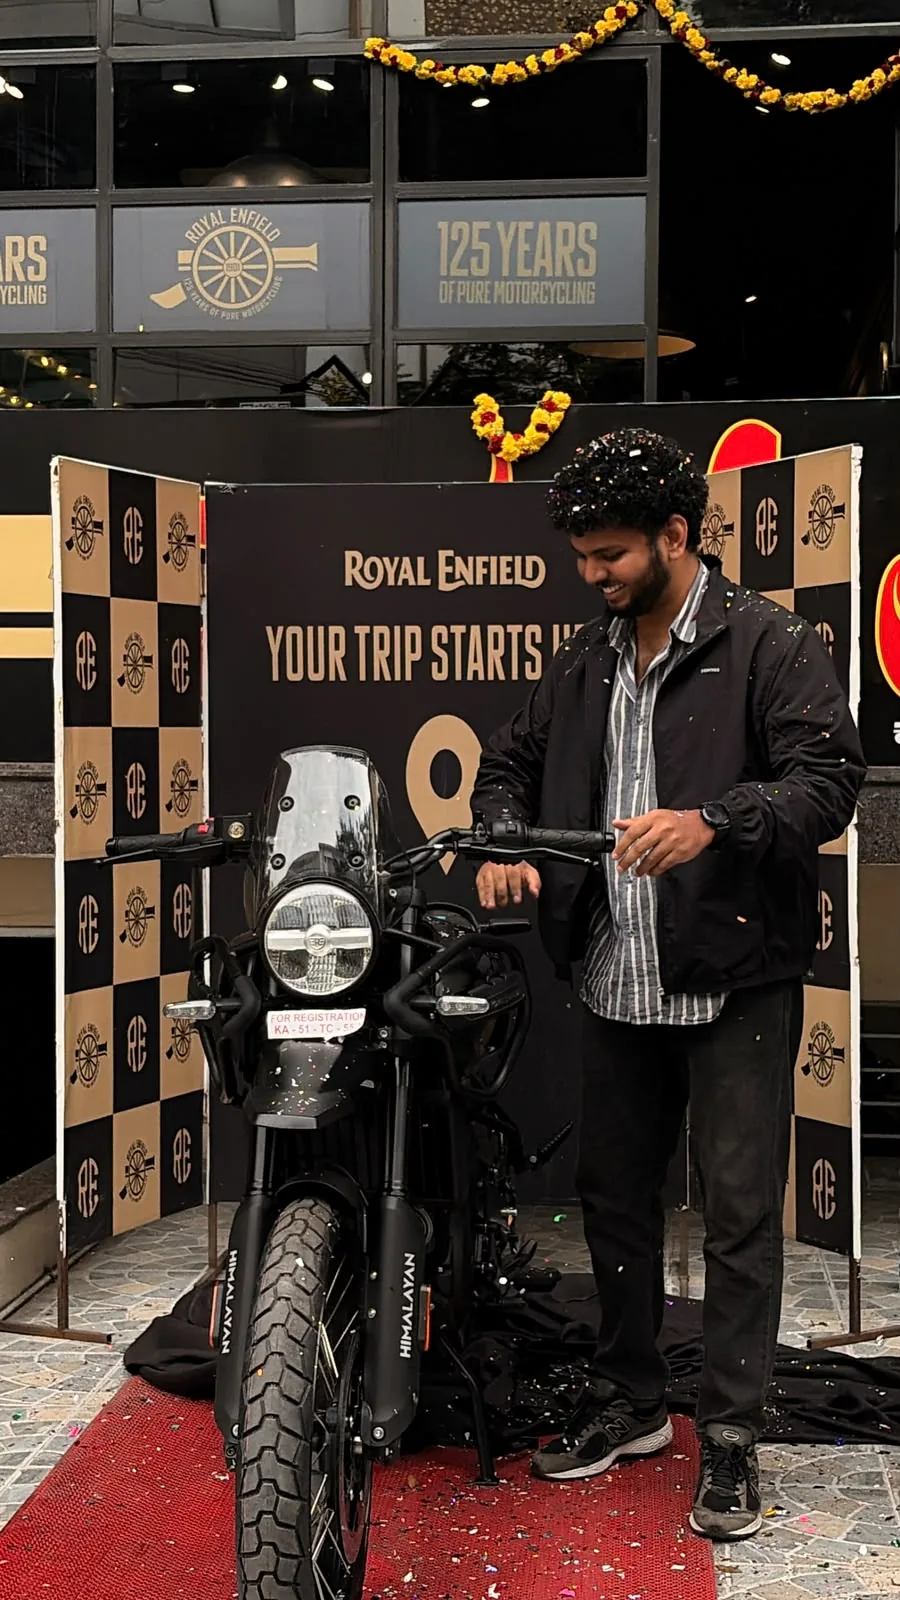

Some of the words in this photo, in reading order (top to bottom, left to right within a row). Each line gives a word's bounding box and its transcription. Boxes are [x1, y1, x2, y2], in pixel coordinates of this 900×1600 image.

[185, 209, 227, 244] ROYAL
[230, 207, 281, 242] ENFIELD
[0, 235, 47, 281] RS
[437, 221, 490, 277] 125
[497, 221, 598, 277] YEARS
[439, 281, 455, 304] OF
[457, 281, 491, 304] PURE
[494, 281, 596, 305] MOTORCYCLING
[344, 550, 431, 590] ROYAL
[438, 549, 547, 592] ENFIELD
[265, 625, 347, 682] YOUR
[354, 625, 422, 682] TRIP
[431, 624, 543, 681] STARTS
[271, 1013, 292, 1023] FOR
[274, 1025, 290, 1034] KA
[298, 1024, 310, 1034] 51
[320, 1023, 334, 1033] TC
[221, 1250, 238, 1354] HIMALAYAN
[400, 1252, 416, 1359] HIMALAYAN
